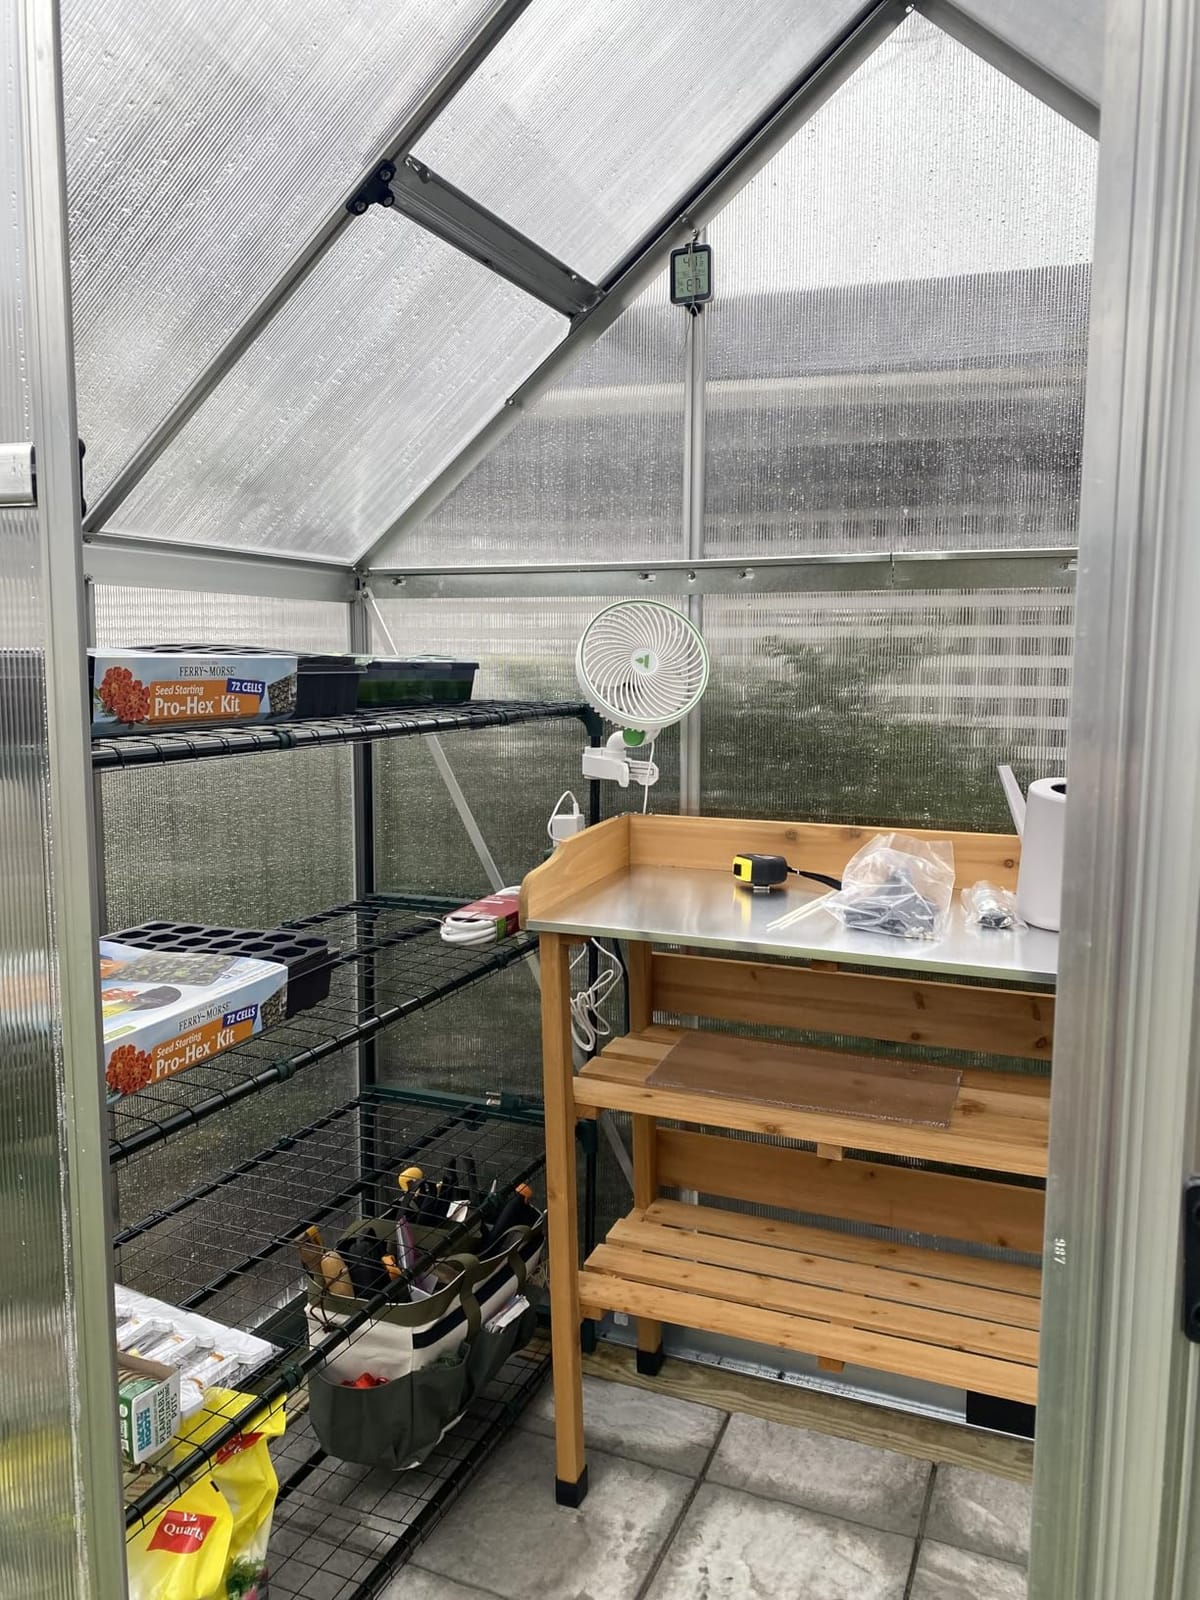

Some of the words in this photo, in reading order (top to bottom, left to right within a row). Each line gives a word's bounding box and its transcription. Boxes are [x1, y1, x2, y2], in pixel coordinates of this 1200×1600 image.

[155, 684, 173, 695] Seed
[174, 683, 204, 696] Starting
[231, 681, 241, 691] 72
[241, 682, 263, 693] CELLS
[154, 695, 214, 716] Pro-Hex
[220, 694, 240, 713] Kit
[226, 1014, 236, 1025] 72
[236, 1006, 256, 1020] CELLS
[156, 1041, 211, 1078] Pro-Hex
[216, 1028, 236, 1050] Kit
[157, 1043, 174, 1058] Seed
[175, 1032, 202, 1049] Starting
[157, 1386, 167, 1444] PLANTABLE
[170, 1392, 178, 1419] POTS
[163, 1522, 205, 1542] Quarts
